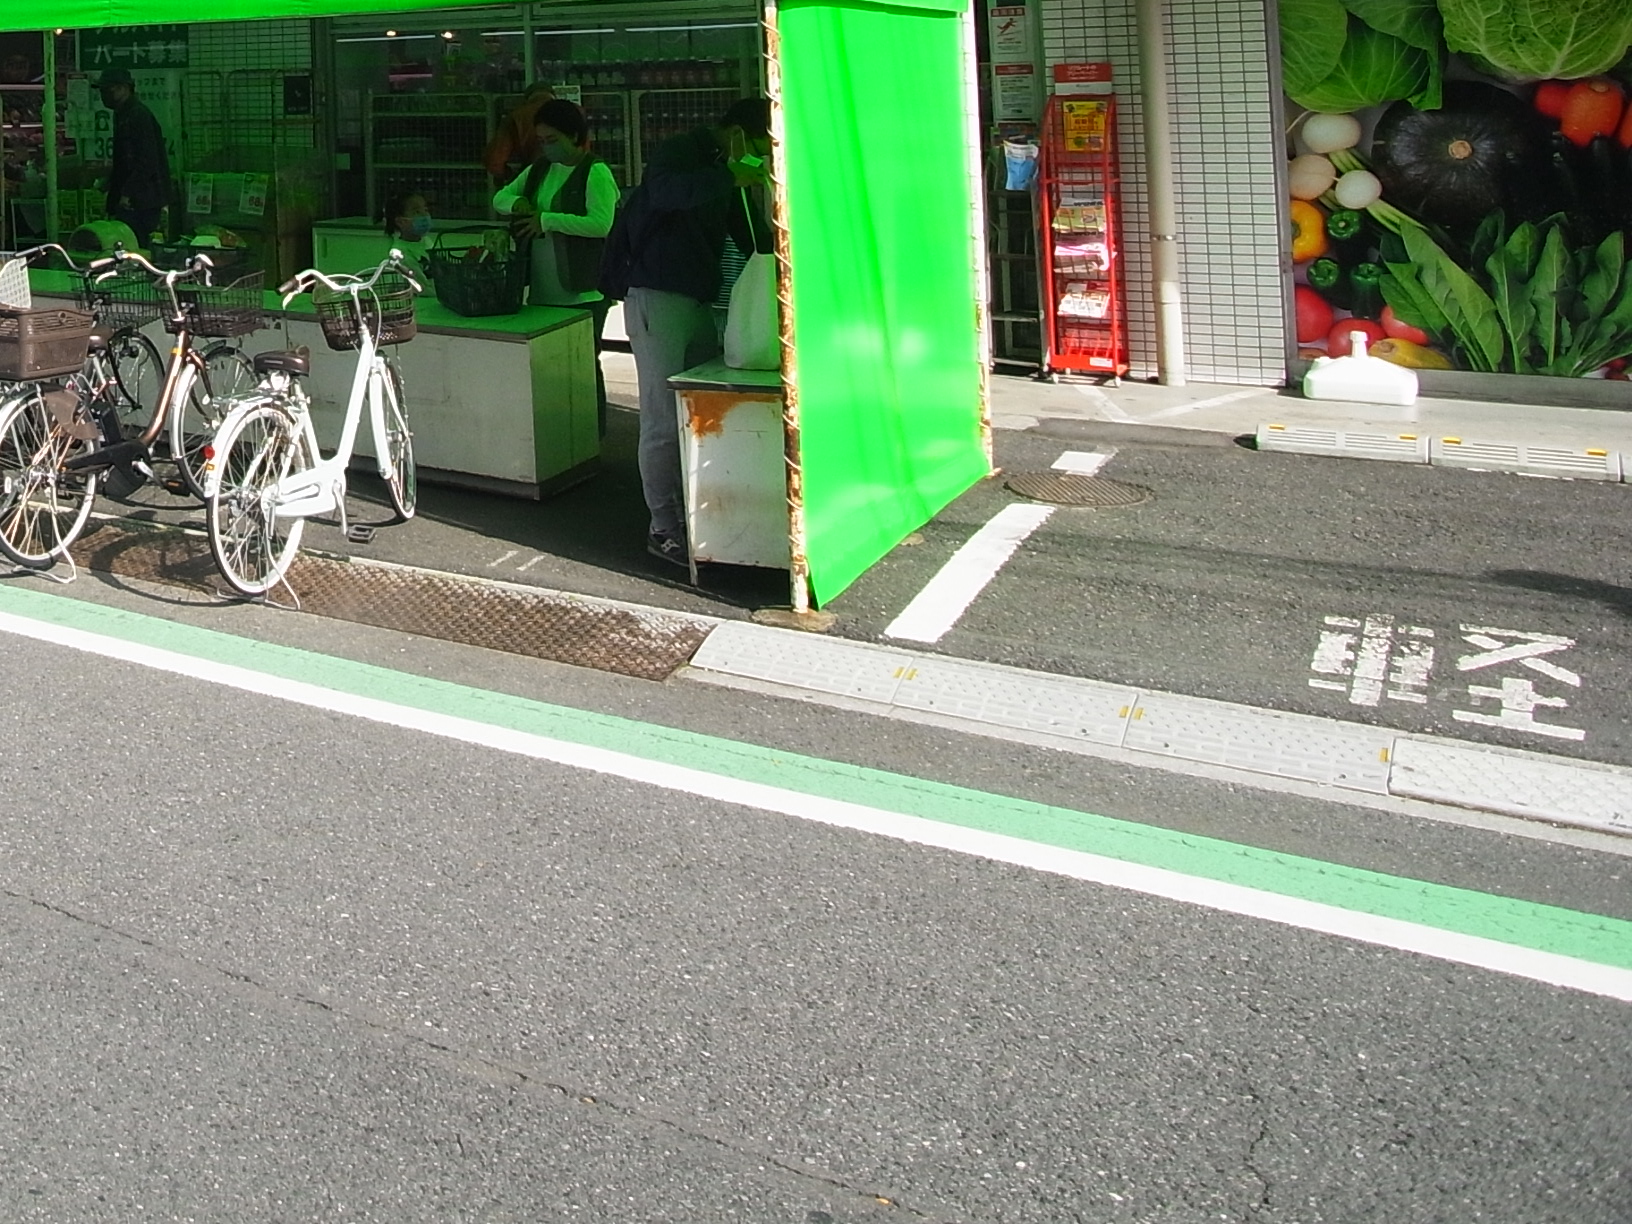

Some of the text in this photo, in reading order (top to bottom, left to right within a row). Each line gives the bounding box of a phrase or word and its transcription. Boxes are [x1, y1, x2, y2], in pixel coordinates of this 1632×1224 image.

[93, 39, 188, 64] パート募集
